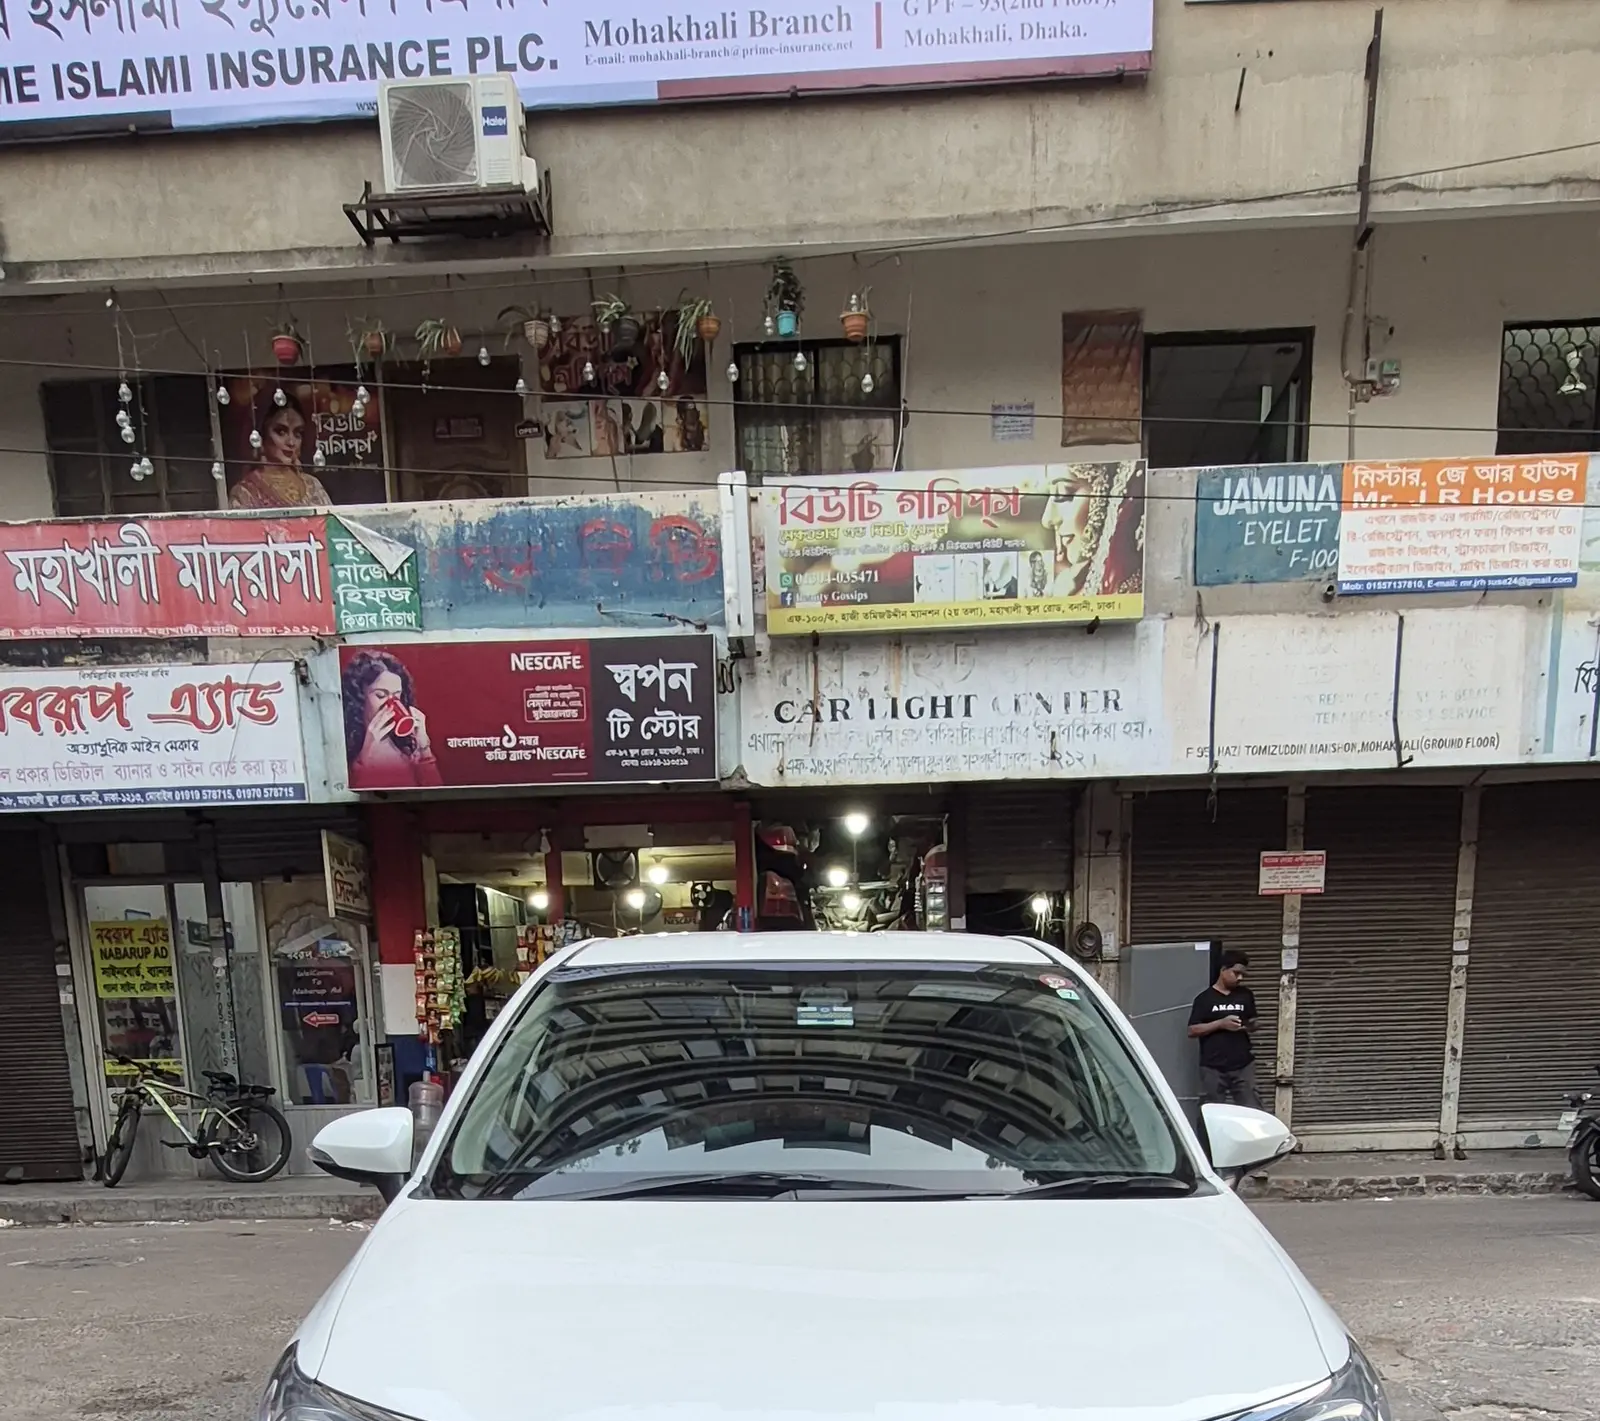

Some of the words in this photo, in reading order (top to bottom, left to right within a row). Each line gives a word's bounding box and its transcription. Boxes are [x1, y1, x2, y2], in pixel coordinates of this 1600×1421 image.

[583, 10, 738, 48] Mohakhali
[747, 5, 853, 39] Branch
[904, 21, 1013, 48] Mohakhali,
[1020, 20, 1088, 41] Dhaka.
[52, 55, 192, 101] ISLAMI
[206, 38, 452, 91] INSURANCE
[467, 33, 558, 73] PLC.
[584, 53, 626, 66] E-mail:
[482, 116, 507, 128] Haier
[1436, 464, 1469, 486] জে
[1474, 463, 1516, 484] আর
[1520, 459, 1579, 483] হাউস
[1212, 474, 1339, 516] JAMUNA
[1353, 490, 1398, 509] Mr.
[1438, 489, 1461, 504] R
[1472, 487, 1575, 505] House
[1243, 518, 1329, 546] EYELET
[4, 521, 162, 614] মহাখালী
[1341, 581, 1365, 591] Mob:
[340, 609, 377, 630] কিতাব
[381, 607, 416, 628] বিভাগ
[604, 658, 699, 703] স্বপন
[774, 697, 853, 724] CAR
[868, 694, 978, 721] LIGHT
[502, 724, 517, 748] ১
[605, 708, 634, 741] টি
[641, 707, 702, 740] স্টোর
[1465, 732, 1500, 750] FLOOR)
[263, 786, 295, 798] 578715
[99, 946, 151, 961] NABARUP
[153, 946, 169, 959] AD
